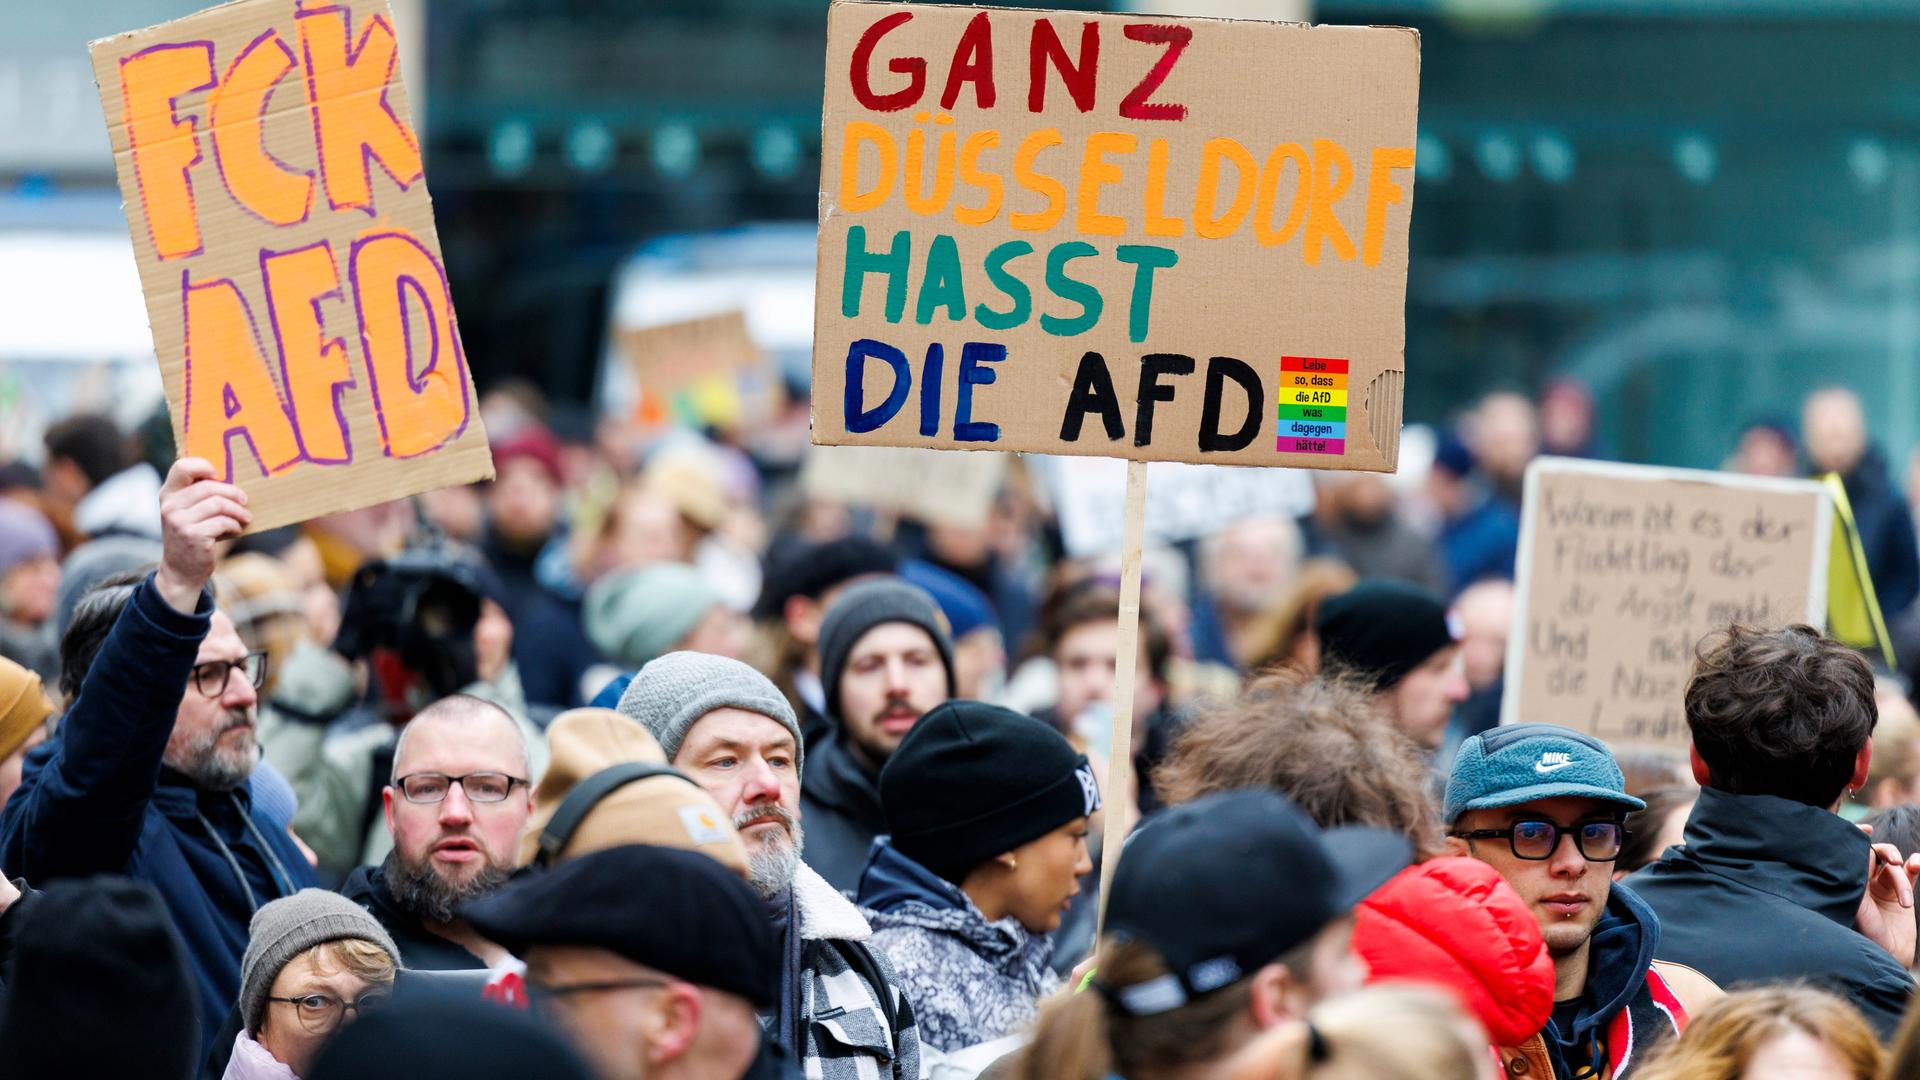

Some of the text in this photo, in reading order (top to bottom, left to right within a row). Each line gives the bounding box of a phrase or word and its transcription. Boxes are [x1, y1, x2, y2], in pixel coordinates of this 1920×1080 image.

[849, 11, 1193, 121] GANZ
[120, 0, 423, 261] FCK
[839, 111, 1415, 267] DÜSSELDORF
[842, 225, 1179, 343] HASST
[182, 227, 469, 483] AFD
[1303, 357, 1326, 369] Lebe
[1294, 374, 1333, 386] so, dass
[844, 339, 1265, 453] DIE AFD
[1295, 391, 1330, 402] die AfD
[1302, 408, 1322, 417] was
[1291, 421, 1332, 436] dagegen
[1295, 440, 1325, 451] hätte!
[1690, 508, 1723, 540] es
[1740, 504, 1806, 543] der
[1542, 751, 1571, 764] NIKE
